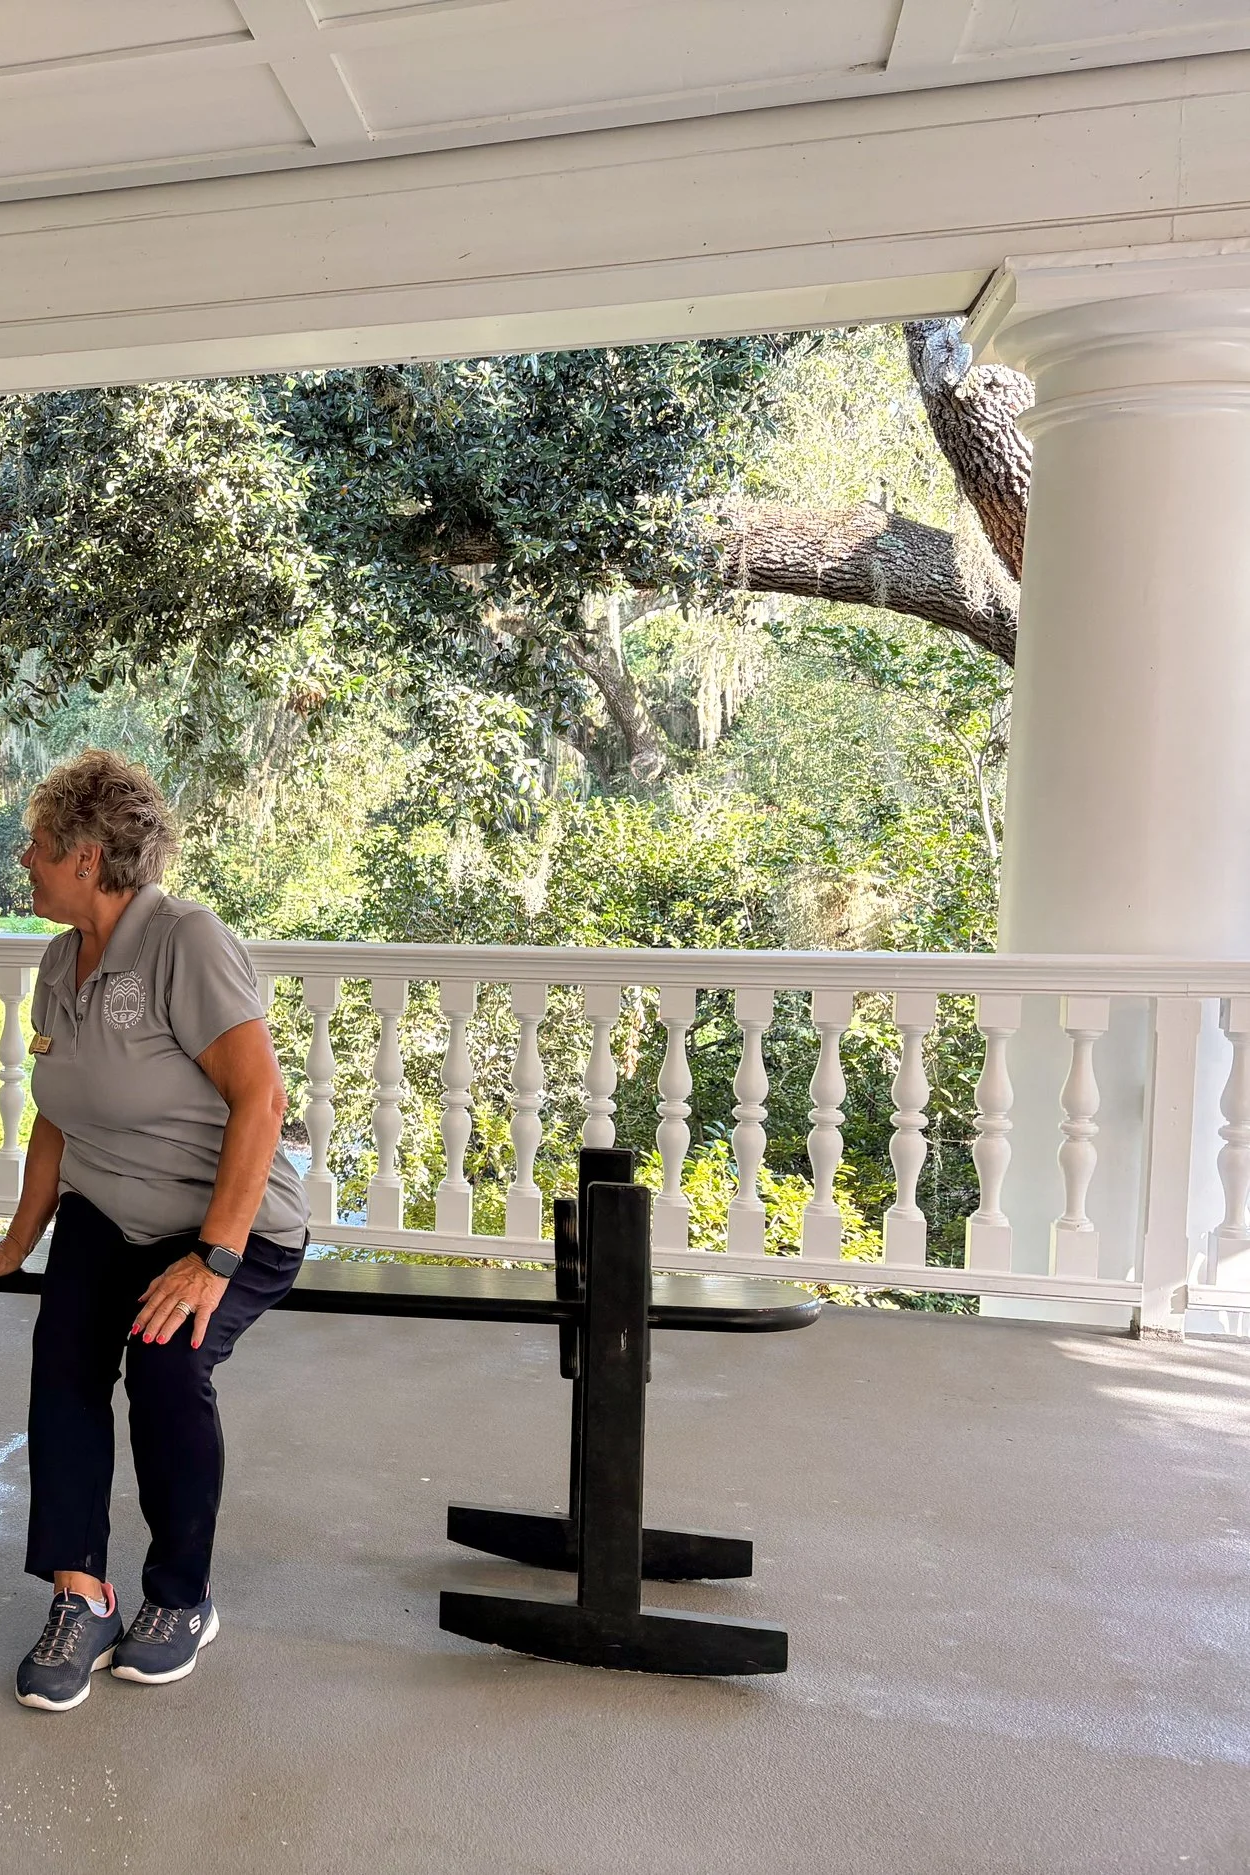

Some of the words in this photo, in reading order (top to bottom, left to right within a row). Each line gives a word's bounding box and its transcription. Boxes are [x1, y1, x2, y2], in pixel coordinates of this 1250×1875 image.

[110, 970, 143, 986] MAGNOLIA
[103, 994, 123, 1030] PLANTATION
[124, 1022, 131, 1030] &
[131, 992, 146, 1026] GARDENS
[188, 1614, 202, 1635] S
